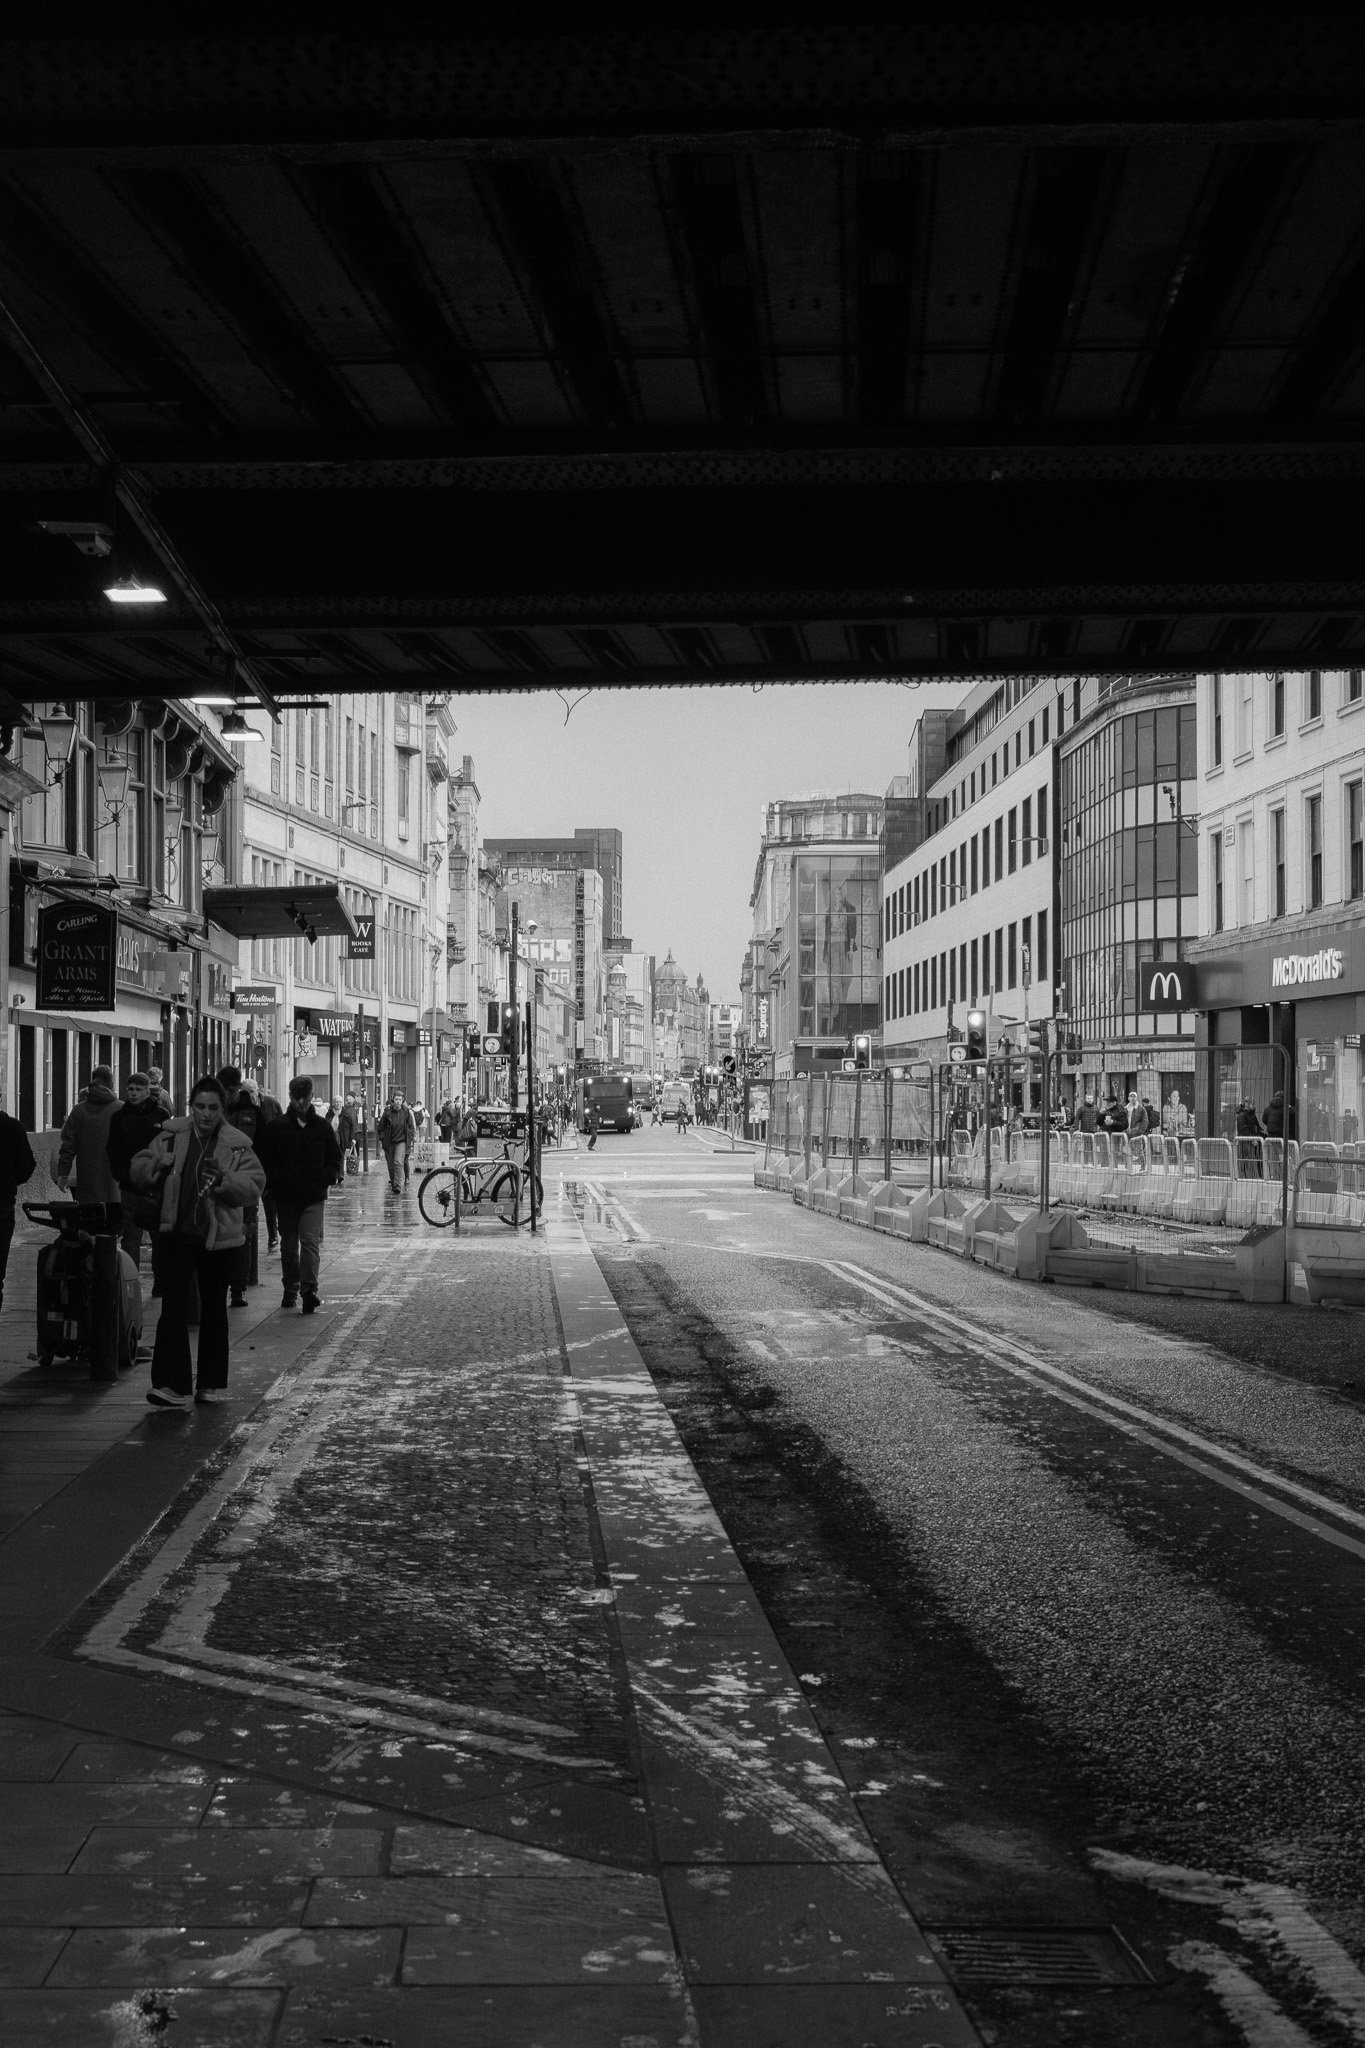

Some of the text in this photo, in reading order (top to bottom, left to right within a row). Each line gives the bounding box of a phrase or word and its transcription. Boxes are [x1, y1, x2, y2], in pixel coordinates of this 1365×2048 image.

[45, 940, 109, 961] GRANT
[54, 966, 98, 981] ARMS
[1272, 947, 1343, 987] McDonald's
[236, 993, 249, 1003] Tim
[249, 993, 275, 1003] Hortons
